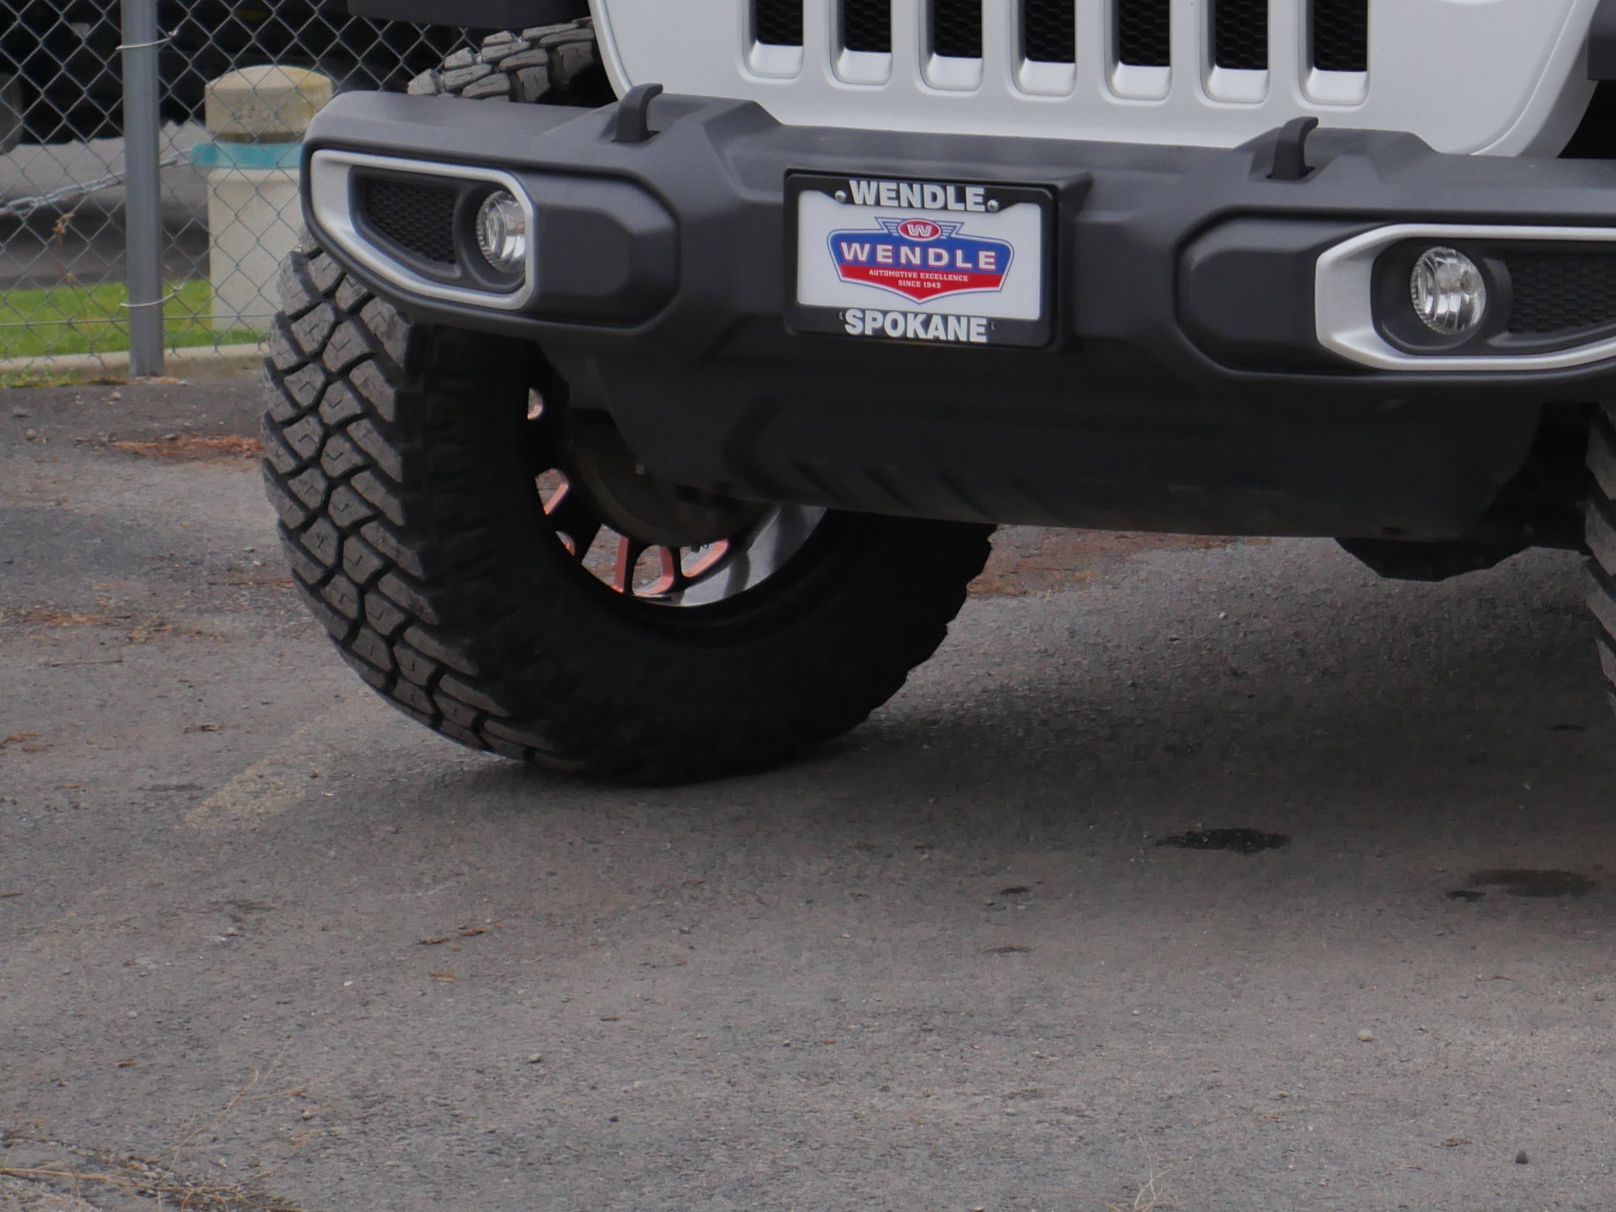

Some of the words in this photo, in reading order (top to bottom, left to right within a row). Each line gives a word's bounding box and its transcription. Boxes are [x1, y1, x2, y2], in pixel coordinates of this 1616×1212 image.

[849, 180, 986, 212] WENDLE
[840, 241, 996, 270] WENDLE
[868, 269, 919, 279] AUTOMOTIVE
[919, 272, 969, 282] EXCELLENCE
[898, 280, 921, 288] SINCE
[923, 281, 941, 289] 1943
[844, 308, 989, 343] SPOKANE
